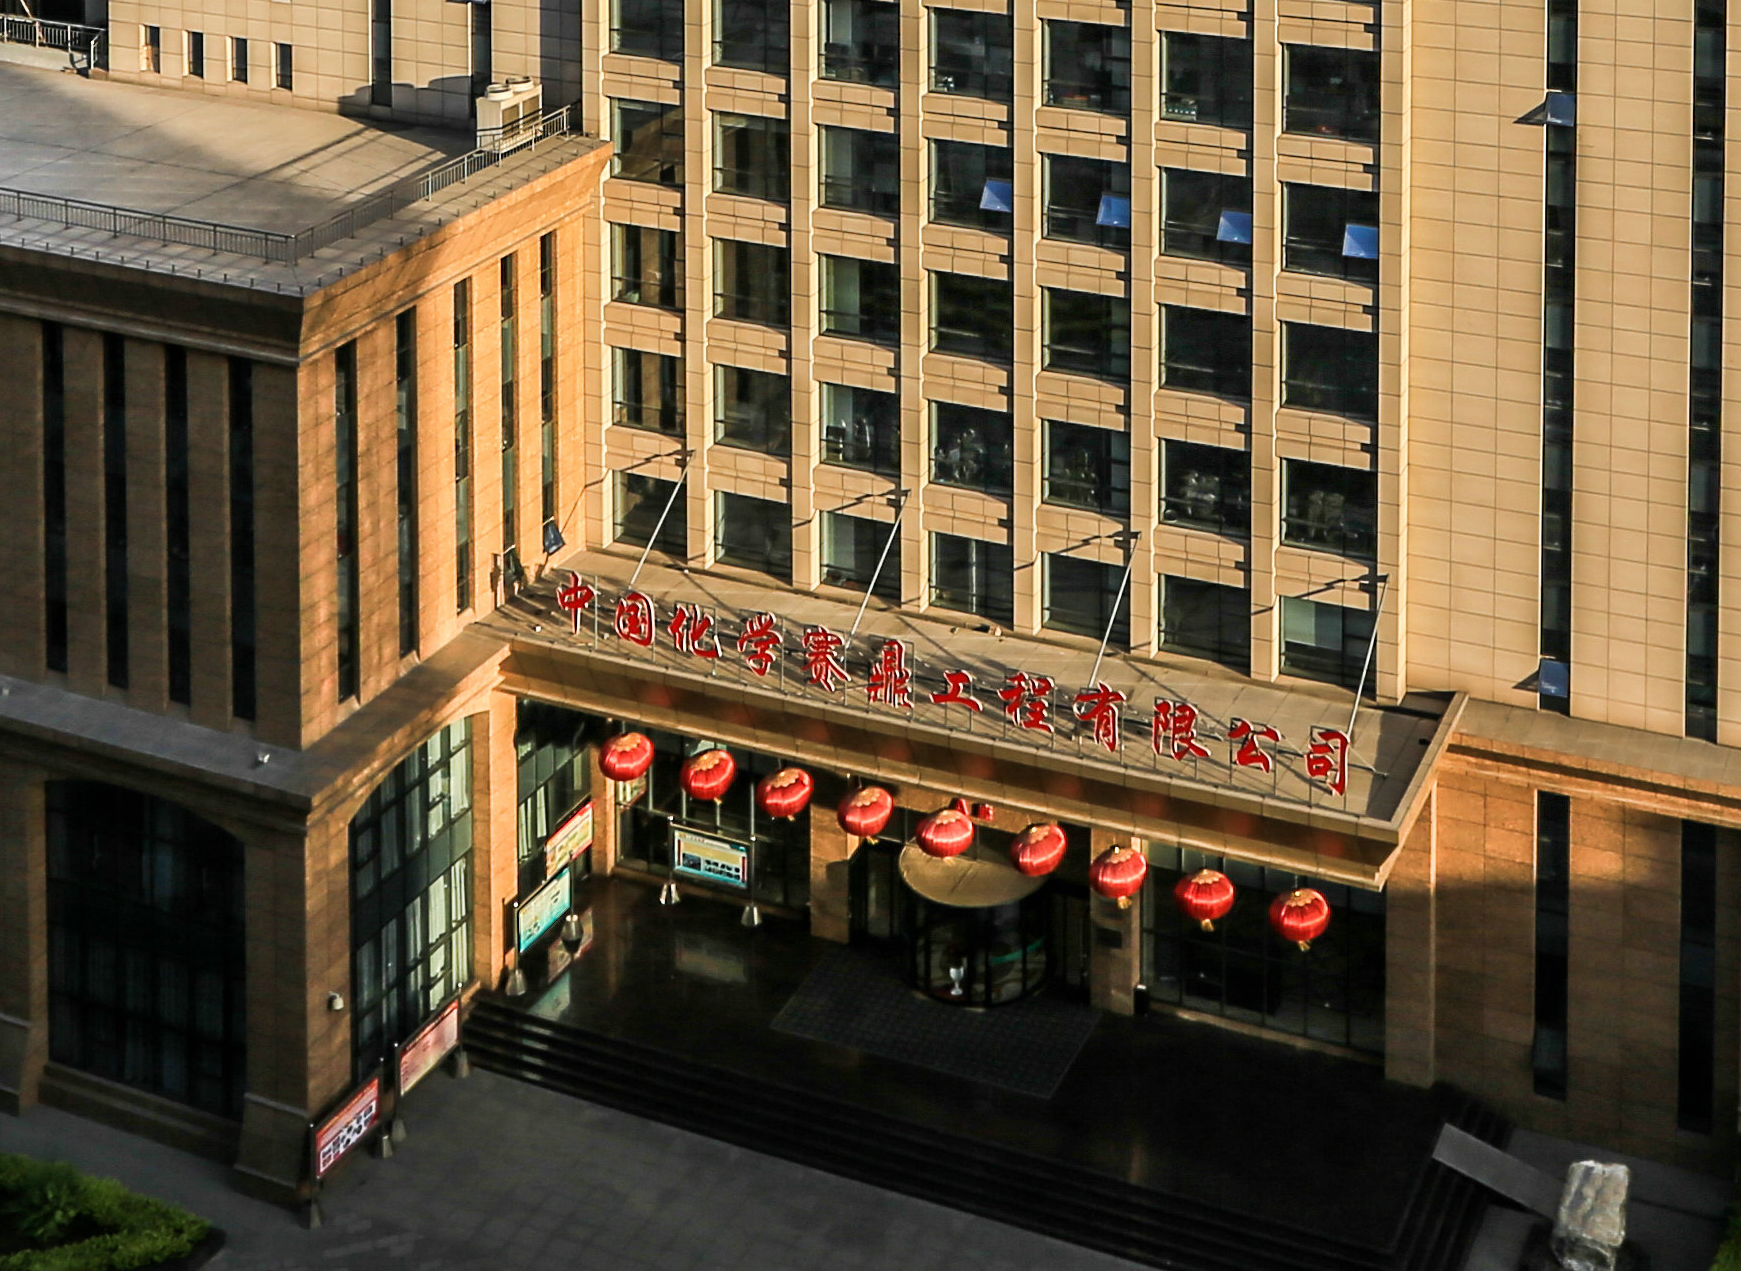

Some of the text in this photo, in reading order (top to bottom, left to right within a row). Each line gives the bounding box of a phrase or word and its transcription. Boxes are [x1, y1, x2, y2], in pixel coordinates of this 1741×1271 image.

[557, 571, 1351, 796] 中国化学赛鼎工程有限公司
